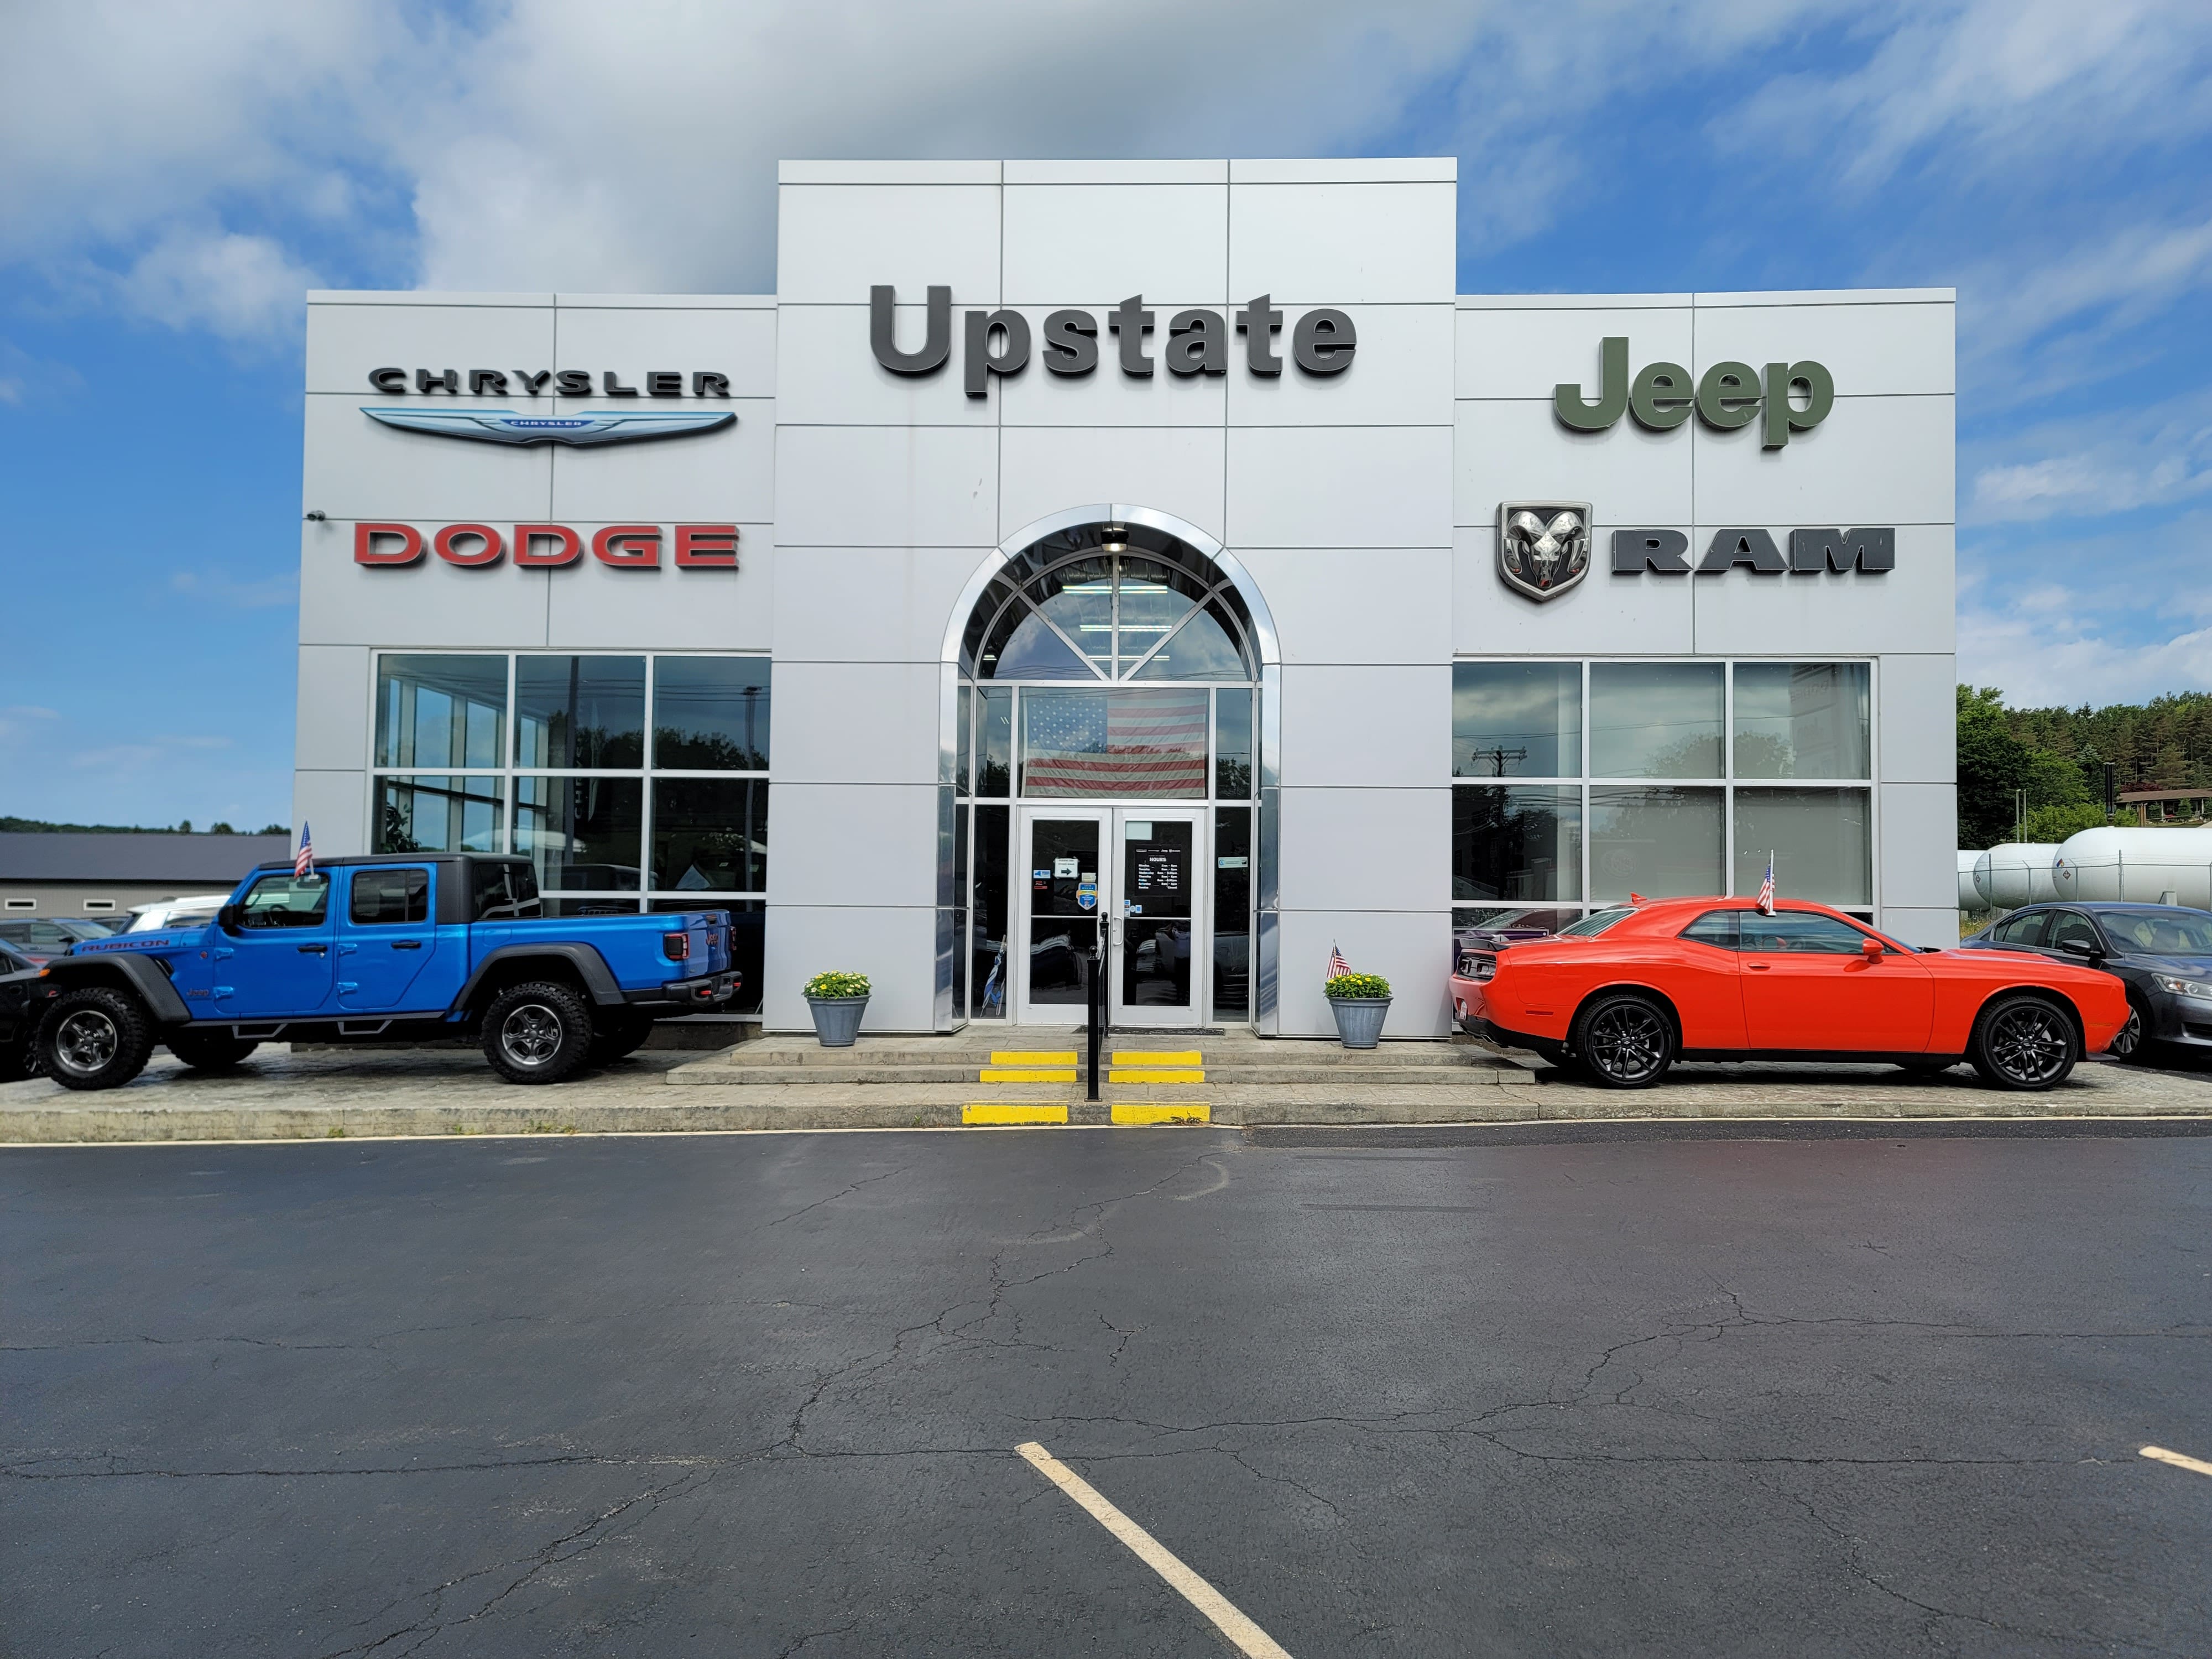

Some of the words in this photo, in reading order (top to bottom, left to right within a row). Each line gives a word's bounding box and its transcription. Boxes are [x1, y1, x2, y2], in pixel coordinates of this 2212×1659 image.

[870, 284, 1357, 399] Upstate
[368, 367, 730, 397] CHRYSLER
[1553, 336, 1834, 450] Jeep
[354, 522, 739, 570] DODGE
[1611, 527, 1896, 575] RAM
[81, 939, 170, 952] RUBICON
